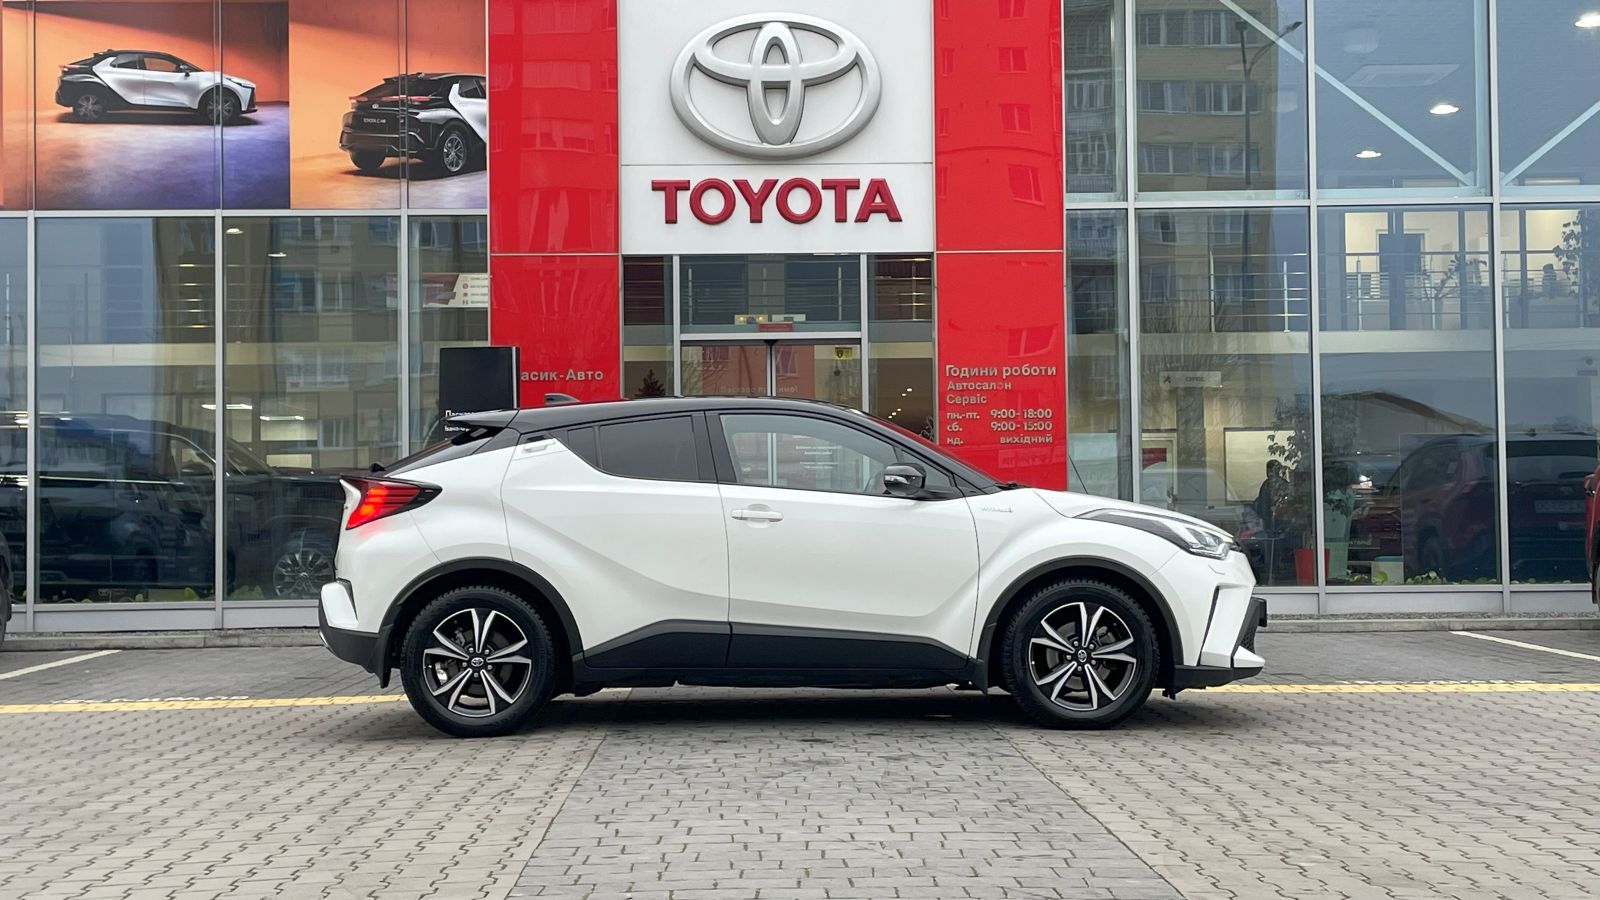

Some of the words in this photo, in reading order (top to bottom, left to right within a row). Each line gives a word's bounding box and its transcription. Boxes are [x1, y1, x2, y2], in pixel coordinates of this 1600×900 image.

[651, 178, 903, 225] TOYOTA
[520, 368, 604, 381] асик-Авто
[945, 364, 998, 379] Години
[1002, 363, 1057, 379] роботи
[947, 381, 1012, 390] Автосалон
[946, 394, 987, 405] Сервіс
[946, 422, 963, 432] сб.
[946, 437, 964, 445] нд.
[1000, 433, 1053, 444] вихідний
